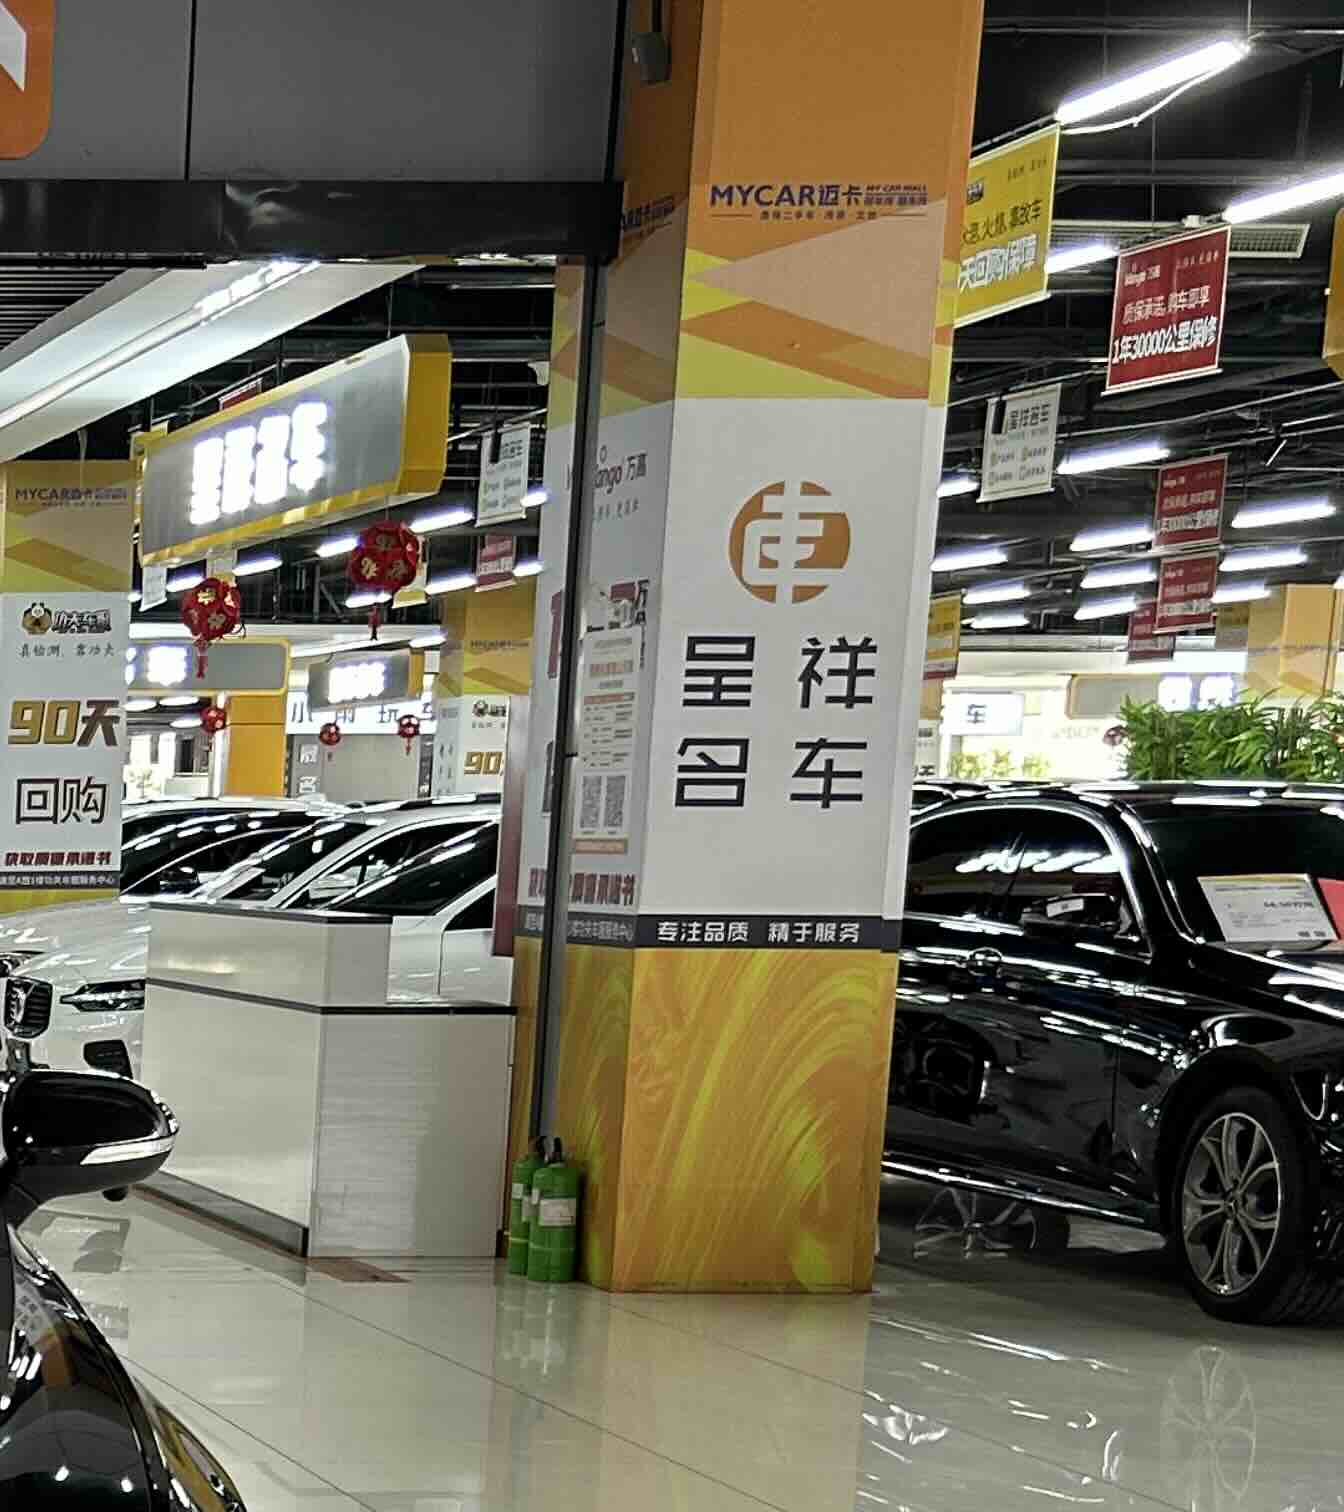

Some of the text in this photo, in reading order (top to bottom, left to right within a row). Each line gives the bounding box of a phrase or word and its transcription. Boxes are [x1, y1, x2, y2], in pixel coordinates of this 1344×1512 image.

[681, 635, 879, 710] 呈祥
[7, 700, 121, 748] 90天
[674, 737, 869, 809] 名车
[15, 776, 108, 825] 回购
[657, 921, 750, 943] 专注品质
[767, 921, 862, 944] 精于服务
